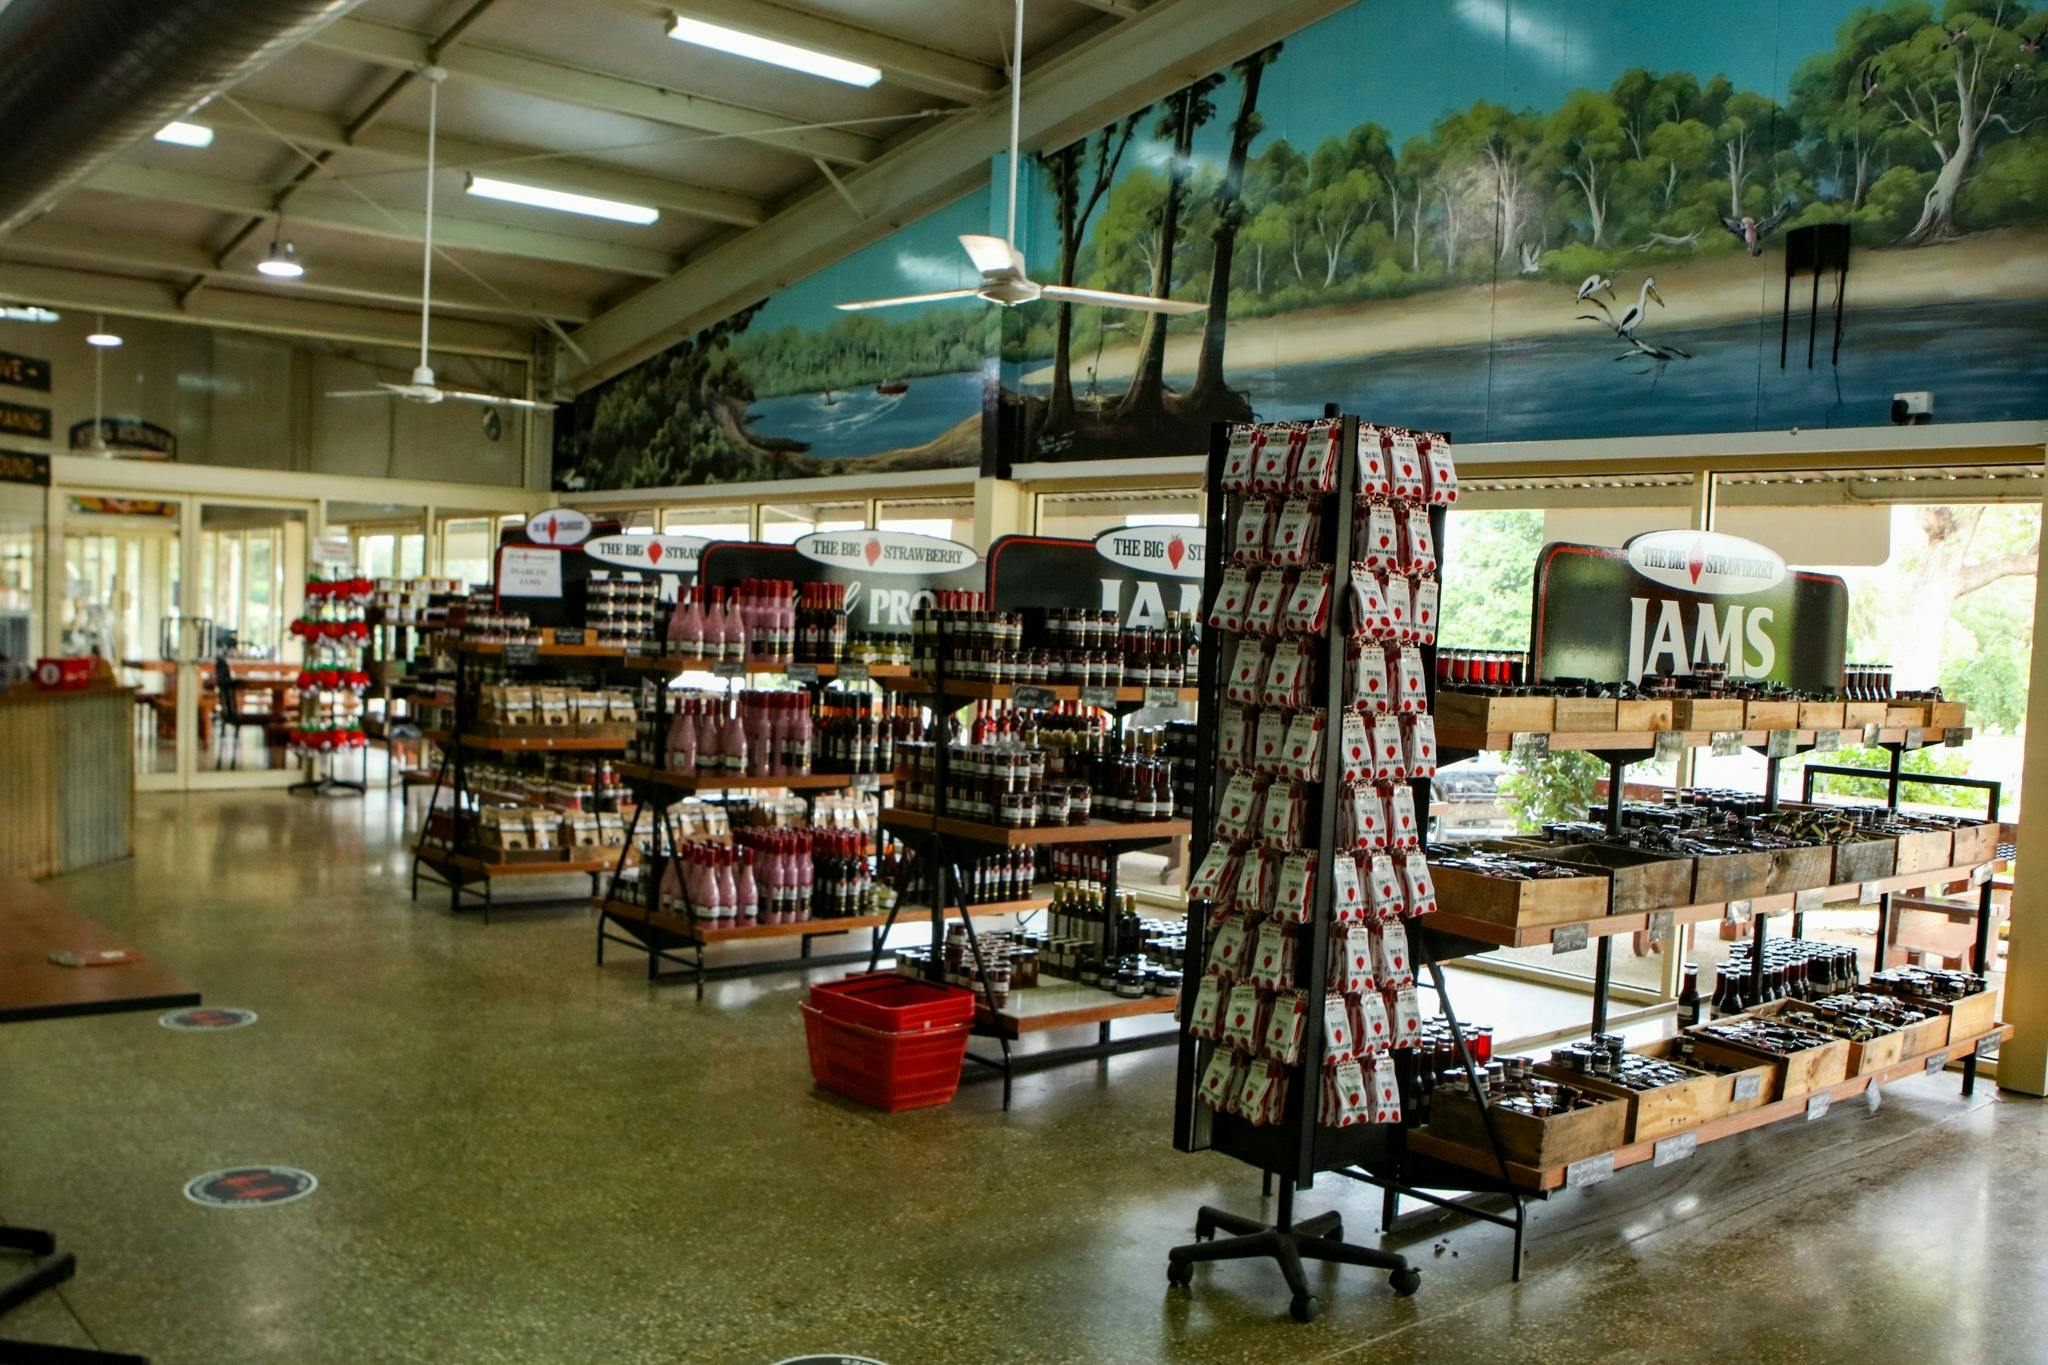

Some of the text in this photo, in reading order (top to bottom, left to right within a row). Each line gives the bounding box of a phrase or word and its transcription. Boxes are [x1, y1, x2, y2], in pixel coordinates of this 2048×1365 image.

[599, 542, 623, 556] THE
[625, 543, 644, 557] BIG
[813, 539, 964, 564] THE BIG STRAWBERRY
[1113, 538, 1140, 557] THE
[1143, 540, 1164, 558] BIG
[1643, 546, 1775, 580] THE BIG STRAWBERRY
[1627, 596, 1776, 690] JAMS
